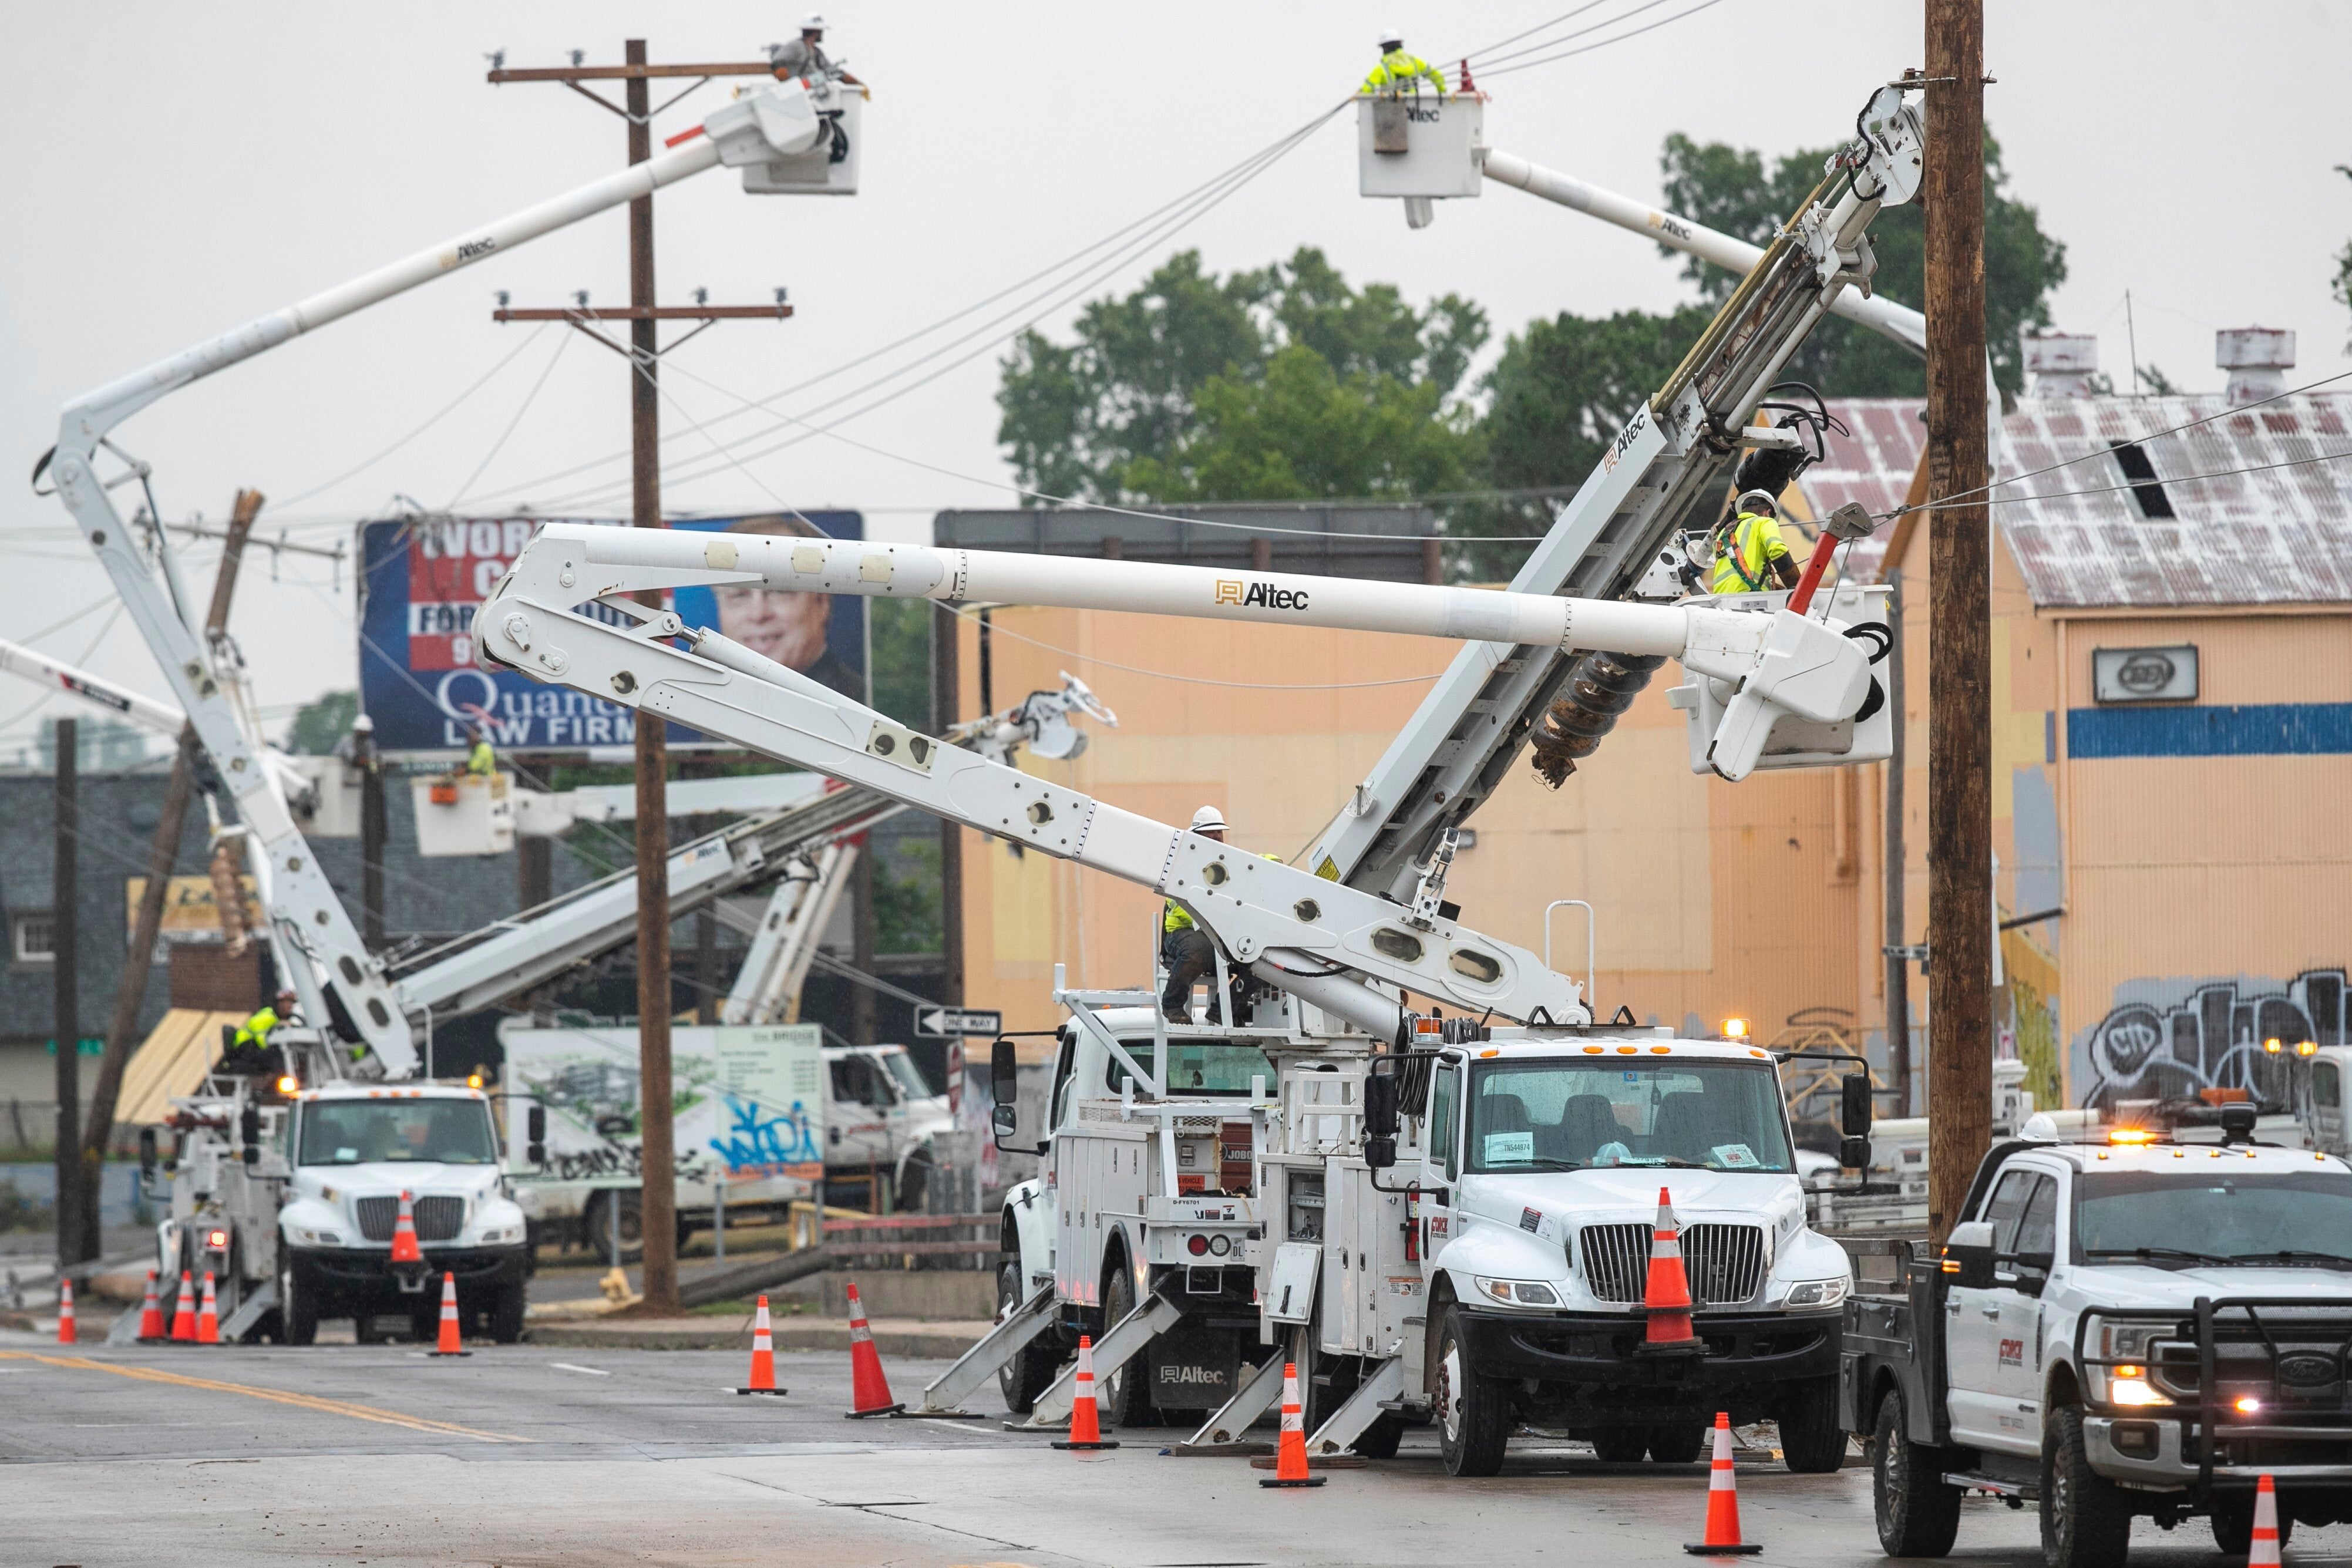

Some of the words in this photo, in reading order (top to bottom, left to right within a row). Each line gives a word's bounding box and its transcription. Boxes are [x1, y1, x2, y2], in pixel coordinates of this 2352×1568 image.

[1661, 217, 1692, 241] Altec
[458, 237, 495, 261] Altec
[1617, 413, 1646, 460] Altec
[1243, 582, 1310, 611] Altec
[444, 717, 531, 745] LAW
[970, 1019, 991, 1027] WAY
[1504, 1143, 1530, 1152] TN544974
[1179, 1366, 1224, 1384] Altec
